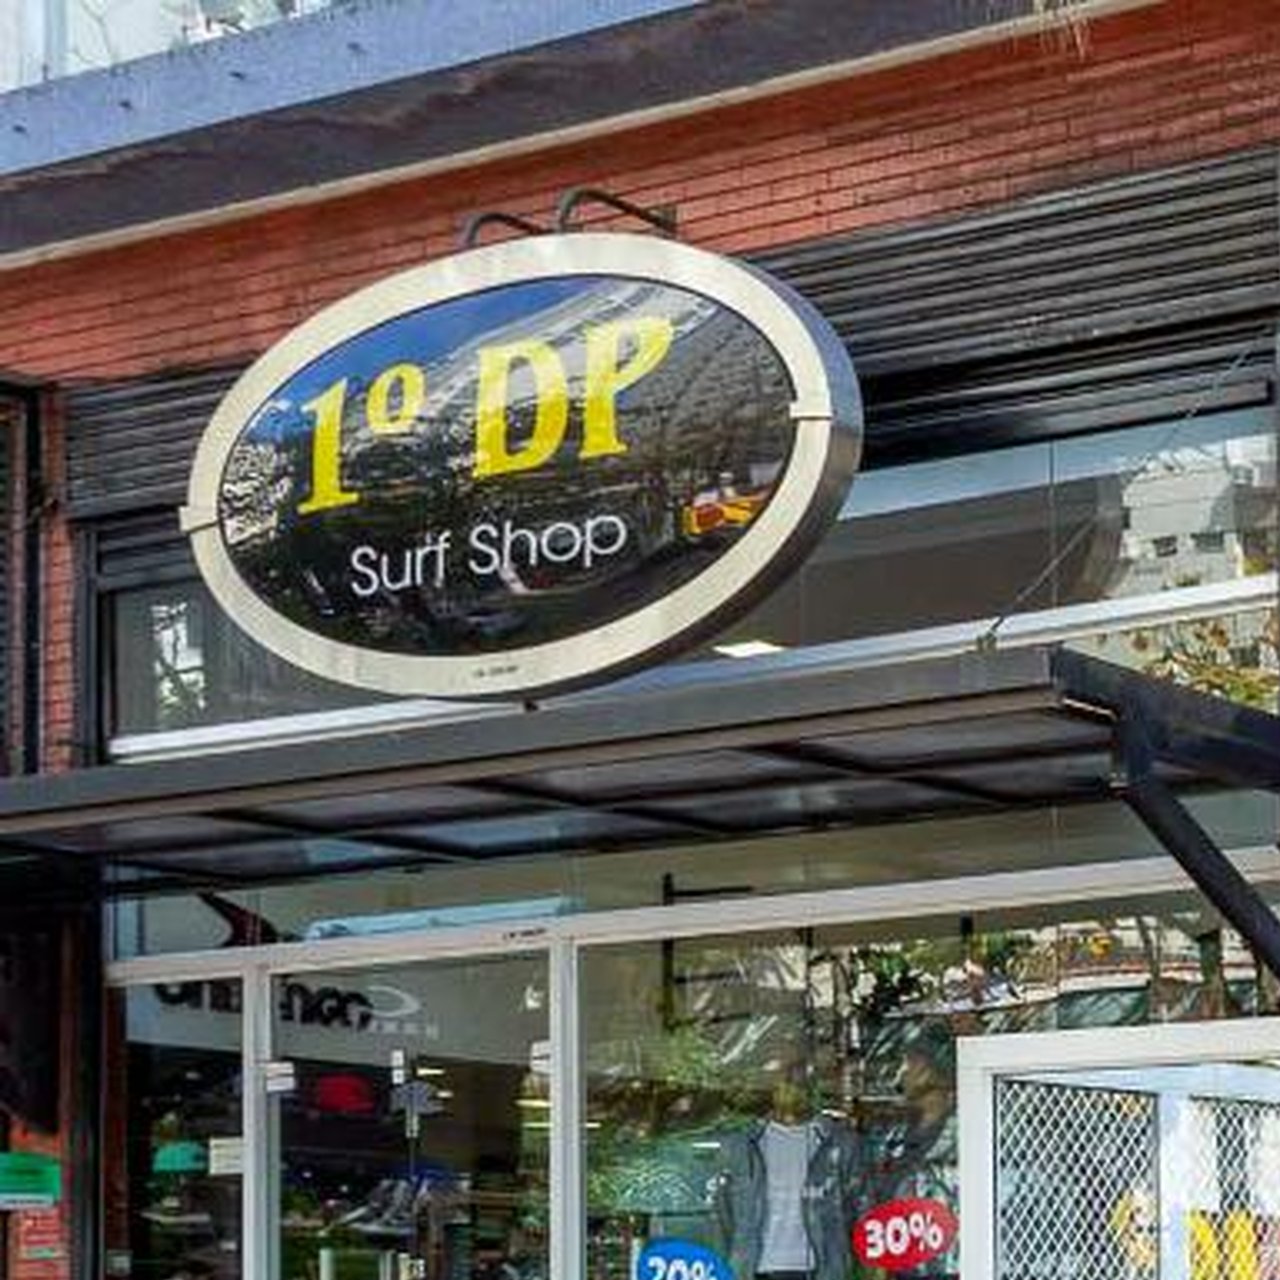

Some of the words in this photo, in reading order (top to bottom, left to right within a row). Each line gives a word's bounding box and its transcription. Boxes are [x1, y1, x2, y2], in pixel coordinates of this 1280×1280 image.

[472, 315, 674, 479] DP
[350, 530, 451, 597] Surf
[468, 514, 628, 576] Shop
[863, 1211, 945, 1259] 30%
